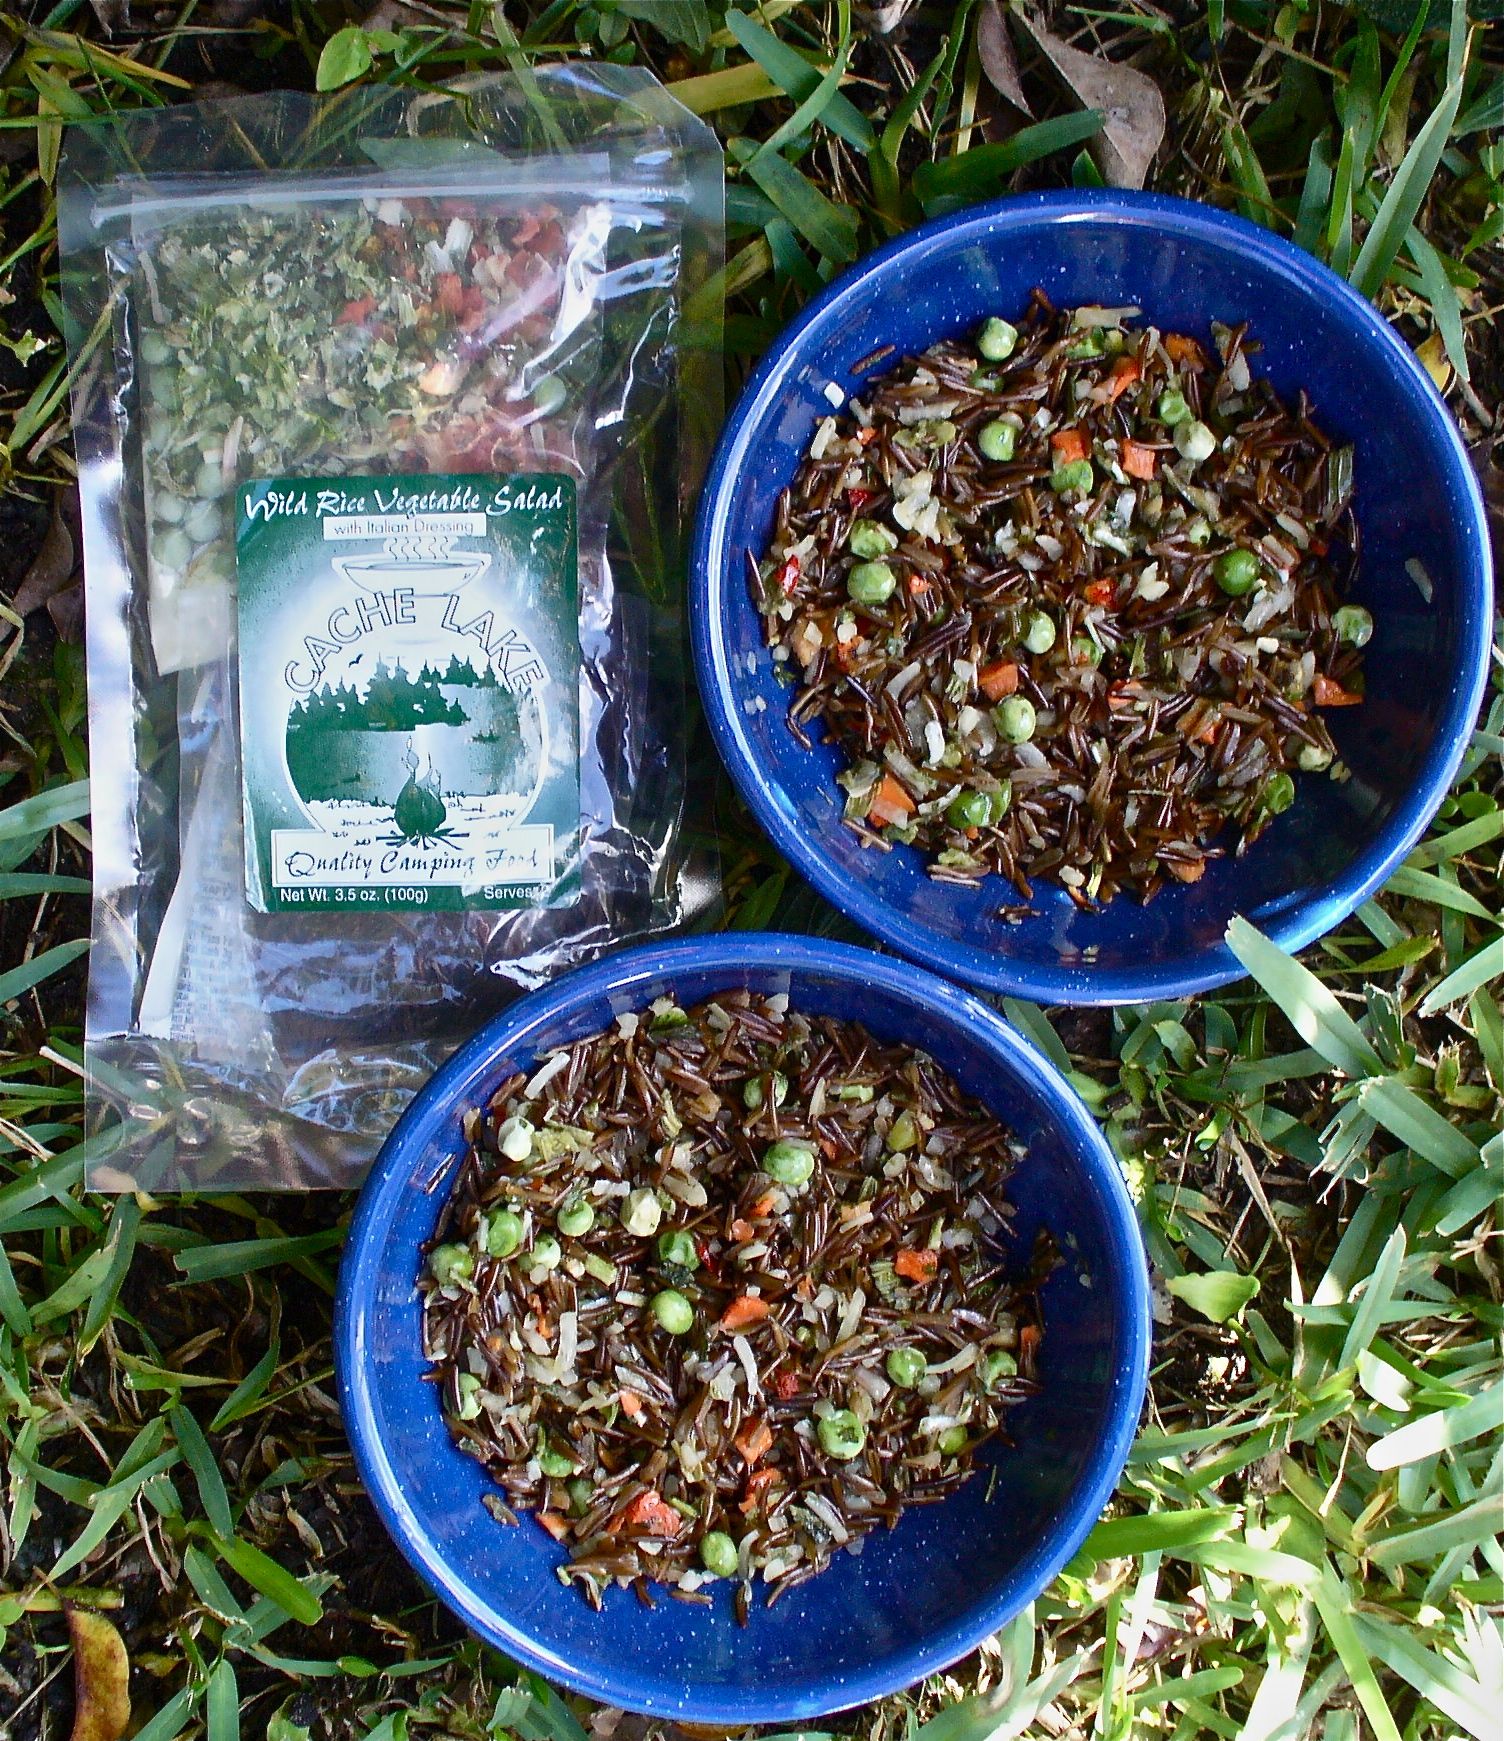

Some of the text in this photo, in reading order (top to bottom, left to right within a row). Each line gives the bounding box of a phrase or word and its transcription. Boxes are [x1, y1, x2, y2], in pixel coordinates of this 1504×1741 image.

[245, 486, 563, 521] Wild Rice Vegetable Salad
[334, 518, 474, 536] with Italian Dressing
[285, 588, 544, 696] CACHE LAKE
[285, 848, 537, 880] Quality Camping Fod
[280, 887, 429, 904] Net Wt. 3.5 oz. (100g)
[484, 886, 533, 900] Serves
